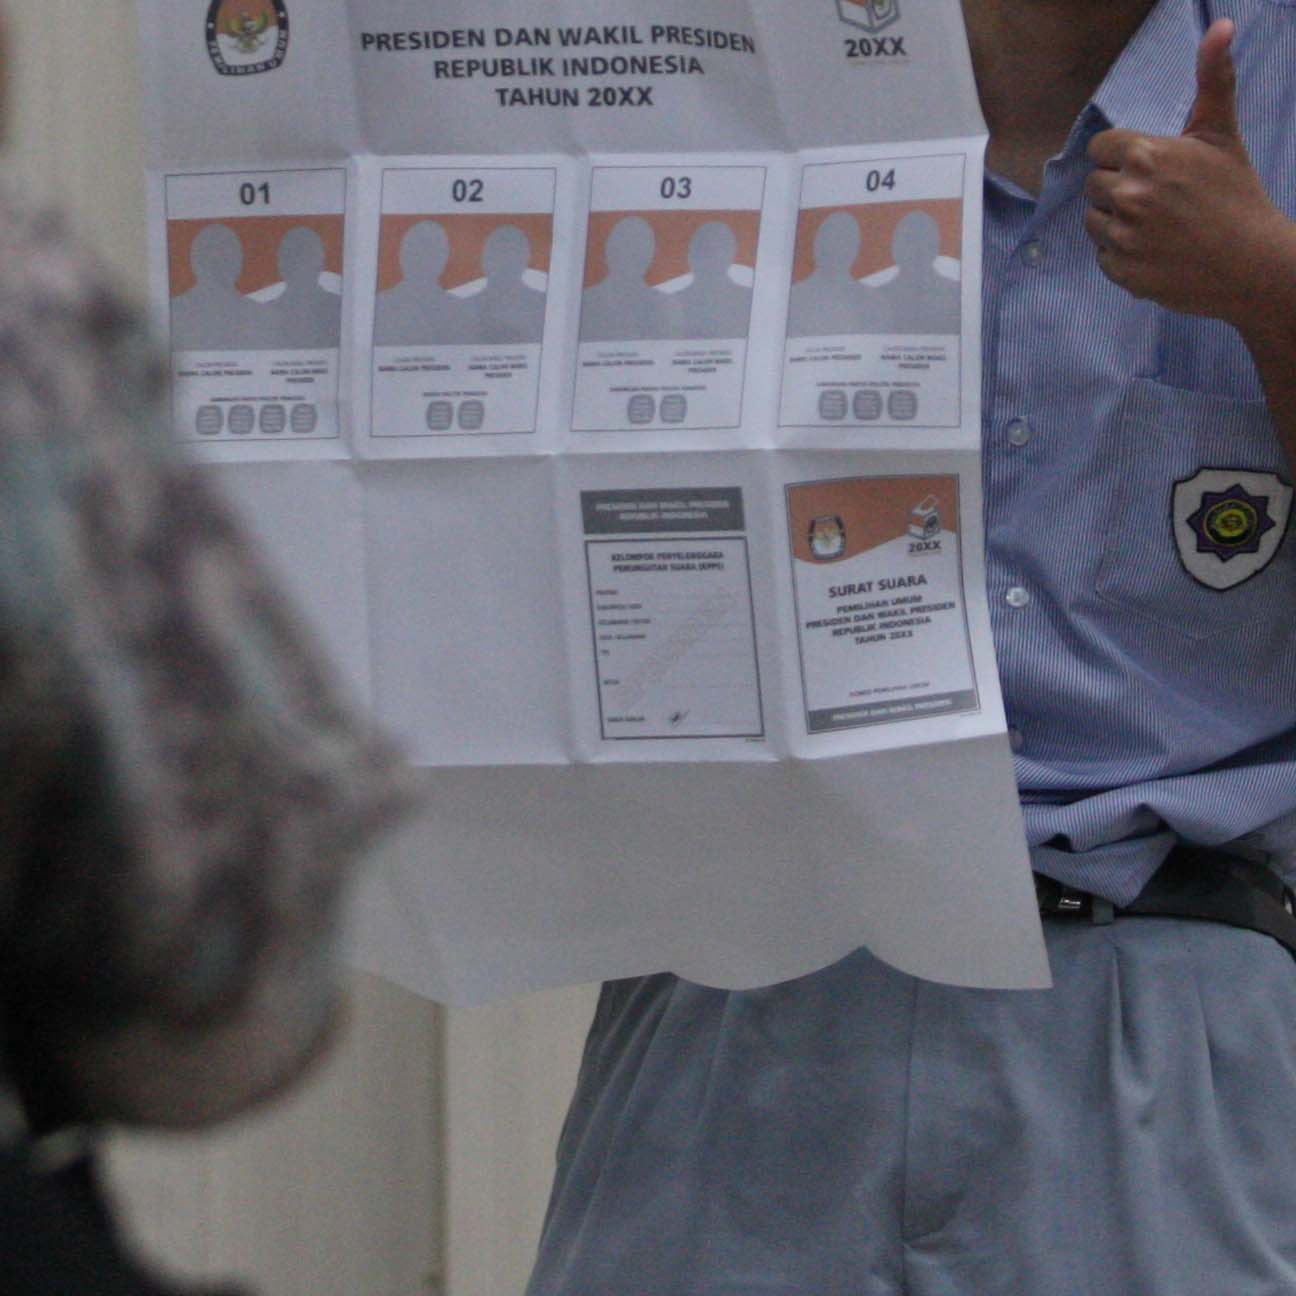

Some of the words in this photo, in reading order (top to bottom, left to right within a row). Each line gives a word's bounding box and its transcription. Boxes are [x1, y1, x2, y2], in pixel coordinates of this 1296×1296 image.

[360, 29, 485, 51] PRESIDEN
[495, 27, 551, 47] DAN
[558, 25, 643, 46] WAKIL
[651, 25, 755, 54] PRESIDEN
[844, 36, 907, 58] 20XX
[434, 57, 555, 79] REPUBLIK
[563, 55, 704, 77] INDONESIA
[496, 87, 579, 107] TAHUN
[588, 86, 654, 107] 20XX
[452, 179, 484, 202] 02
[660, 176, 692, 199] 03
[865, 168, 896, 192] 04
[240, 182, 271, 205] 01
[909, 540, 942, 553] 20XX
[828, 581, 874, 598] SURAT
[878, 574, 928, 591] SUARA
[854, 613, 875, 622] DAN
[855, 633, 887, 645] TAHUN
